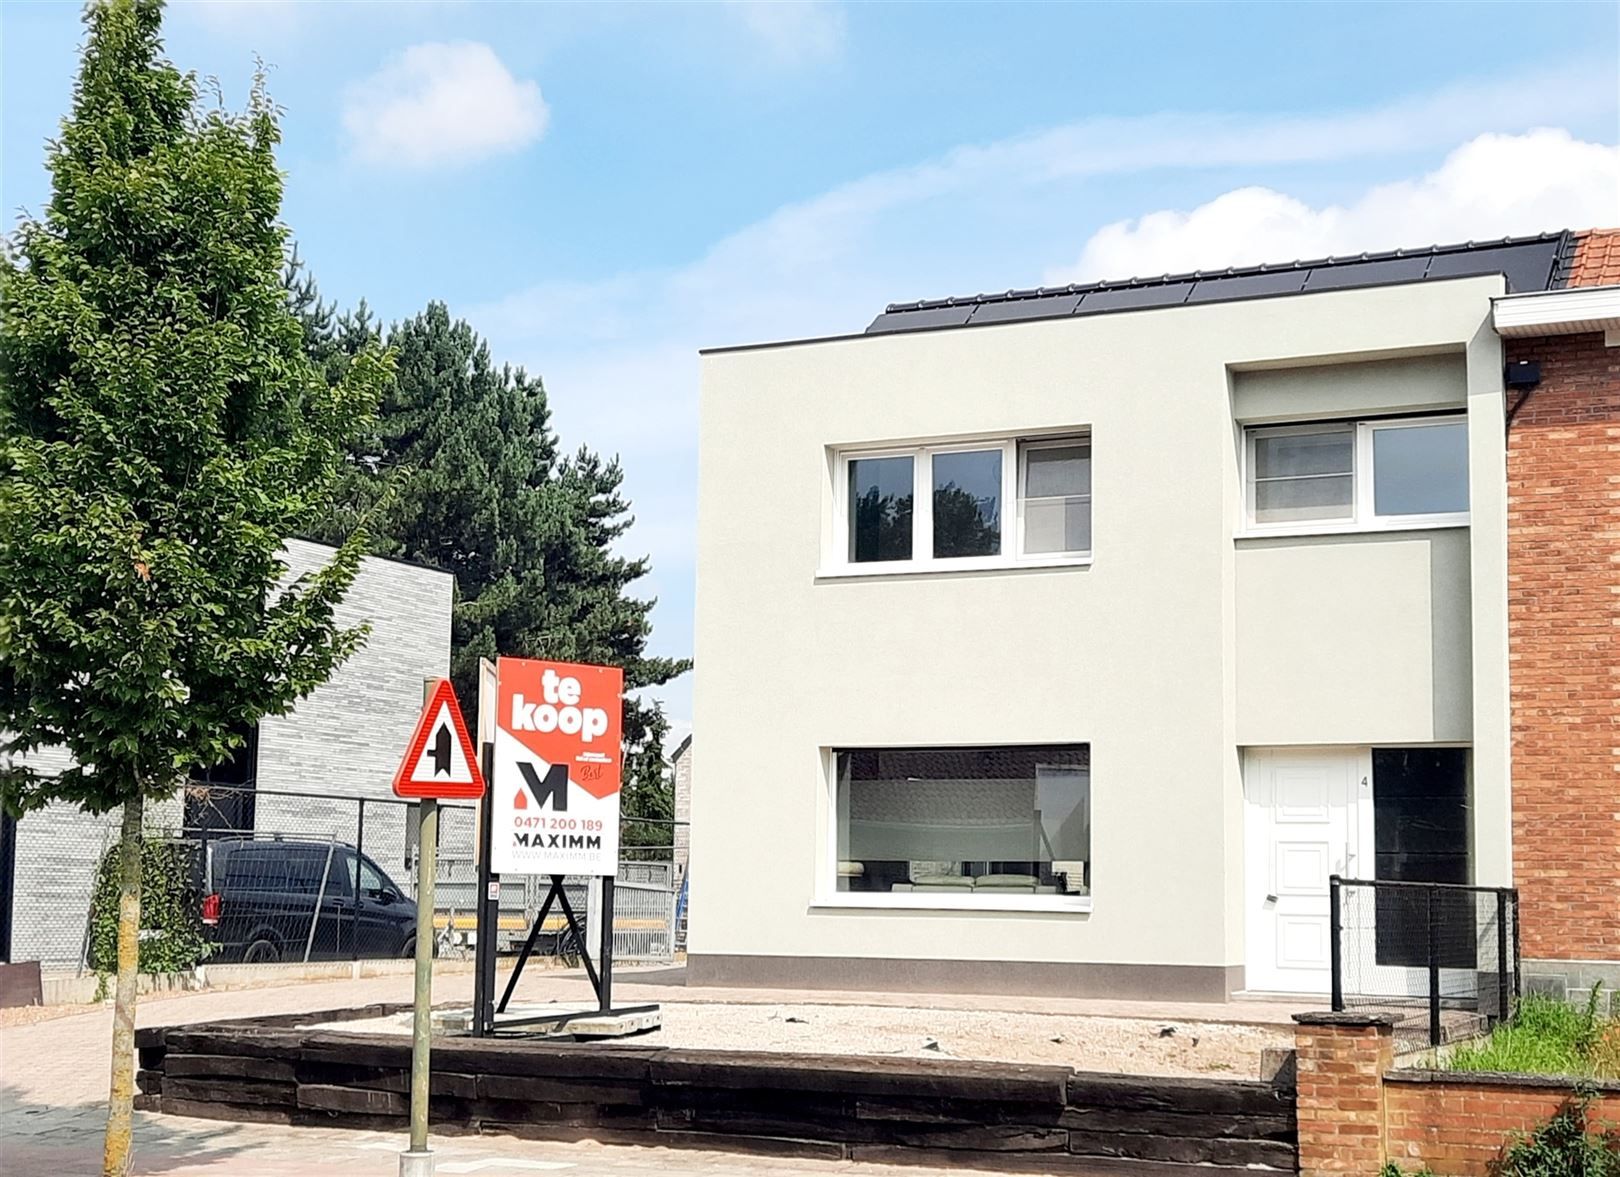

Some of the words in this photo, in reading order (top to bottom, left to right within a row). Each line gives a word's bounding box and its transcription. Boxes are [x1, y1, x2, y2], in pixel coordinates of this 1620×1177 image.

[541, 669, 581, 705] te
[512, 693, 608, 742] koop
[1361, 776, 1368, 788] 4
[514, 816, 546, 829] 0471
[550, 818, 576, 830] 200
[581, 819, 603, 831] 189
[513, 832, 601, 849] MAXIMM
